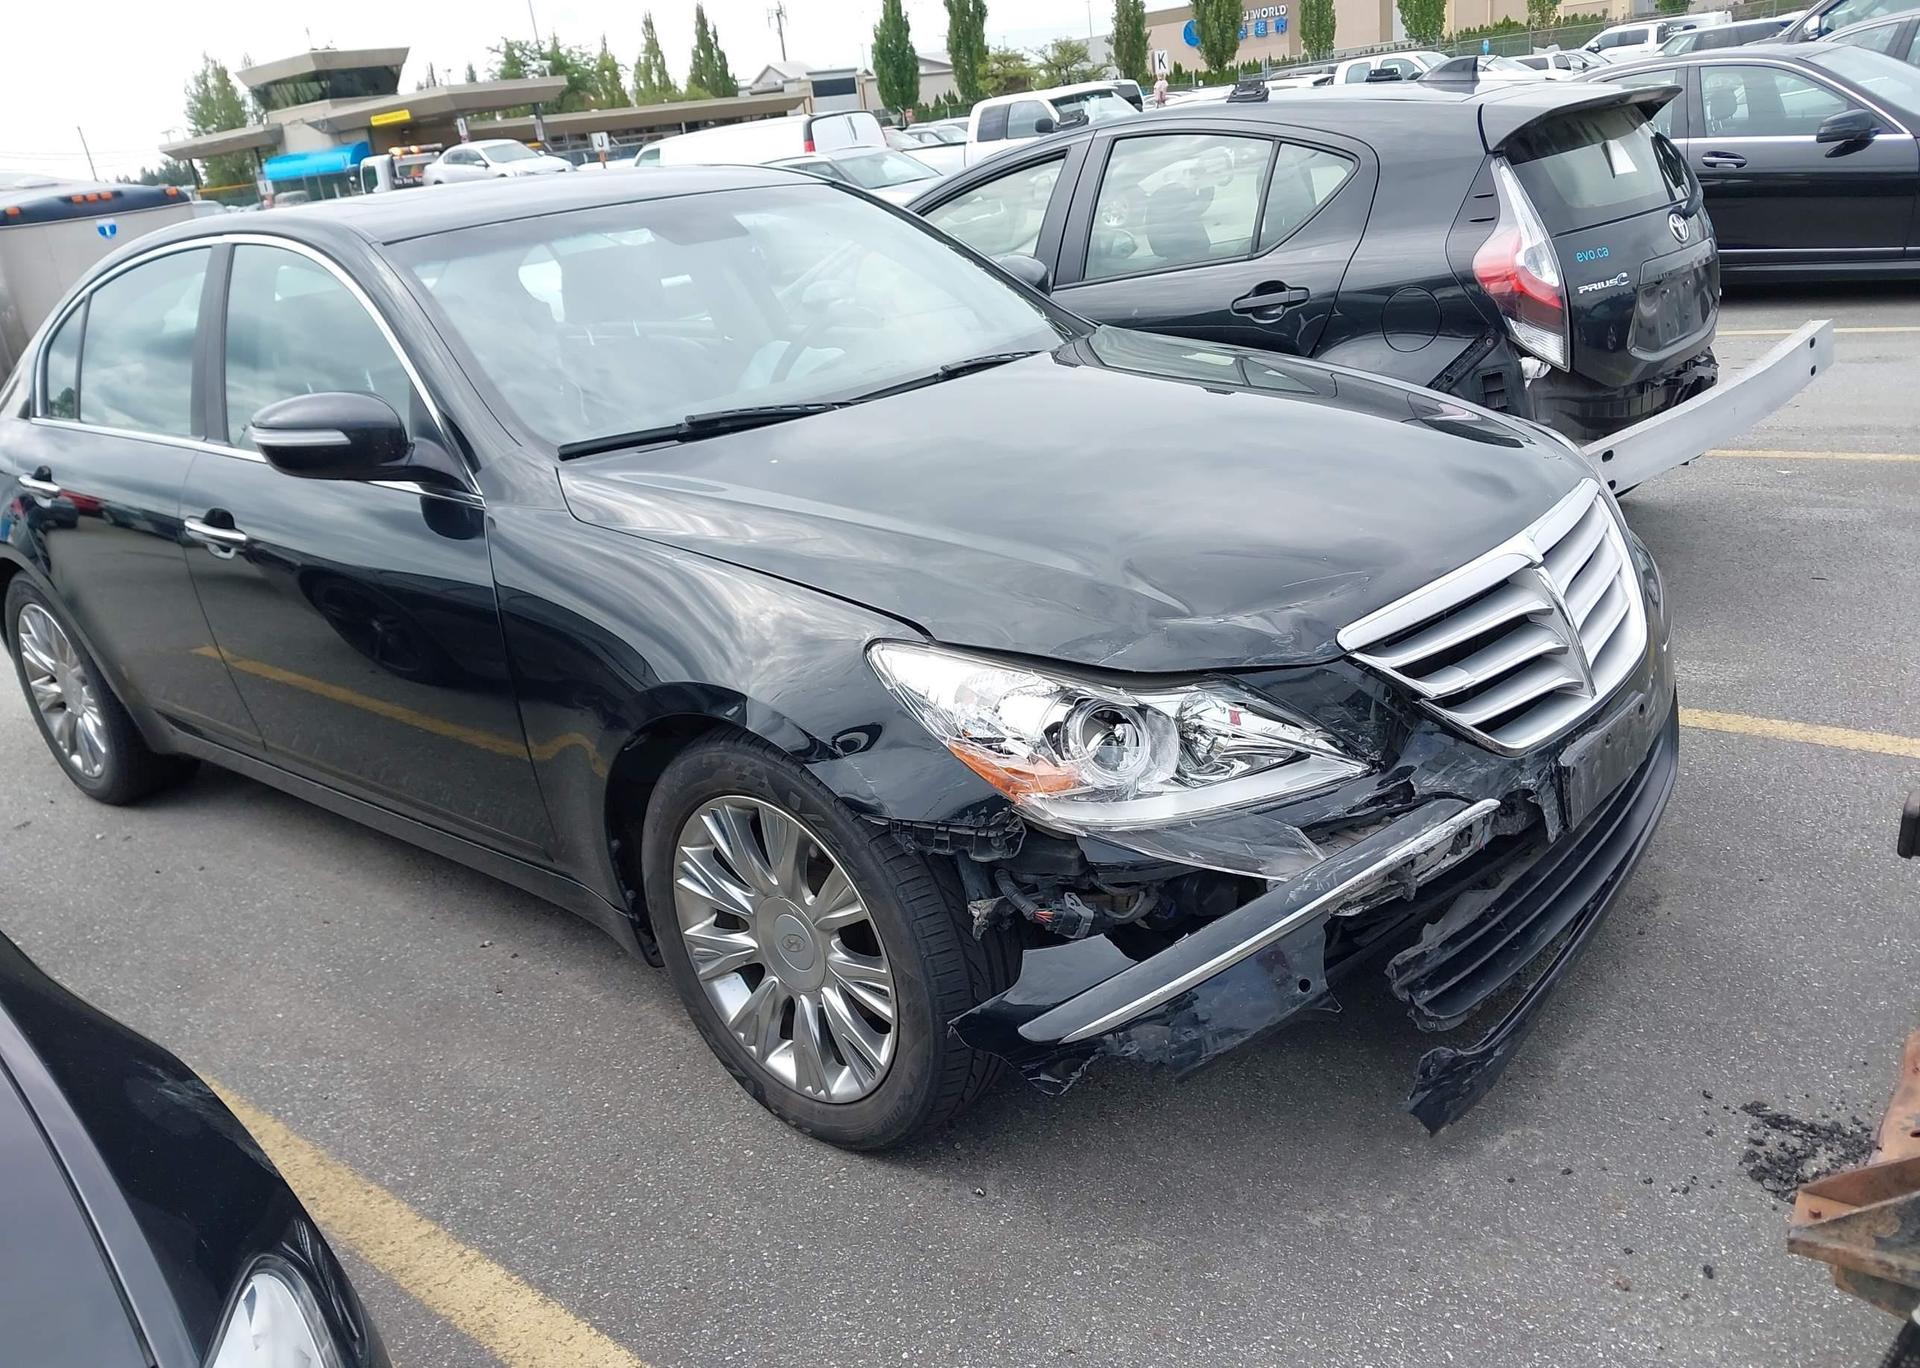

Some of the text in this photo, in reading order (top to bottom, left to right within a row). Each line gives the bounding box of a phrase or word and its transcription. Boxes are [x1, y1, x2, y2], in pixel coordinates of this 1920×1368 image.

[1252, 4, 1287, 20] WORLD
[1158, 52, 1166, 70] K
[598, 135, 604, 148] J
[1576, 247, 1609, 263] evo.ca
